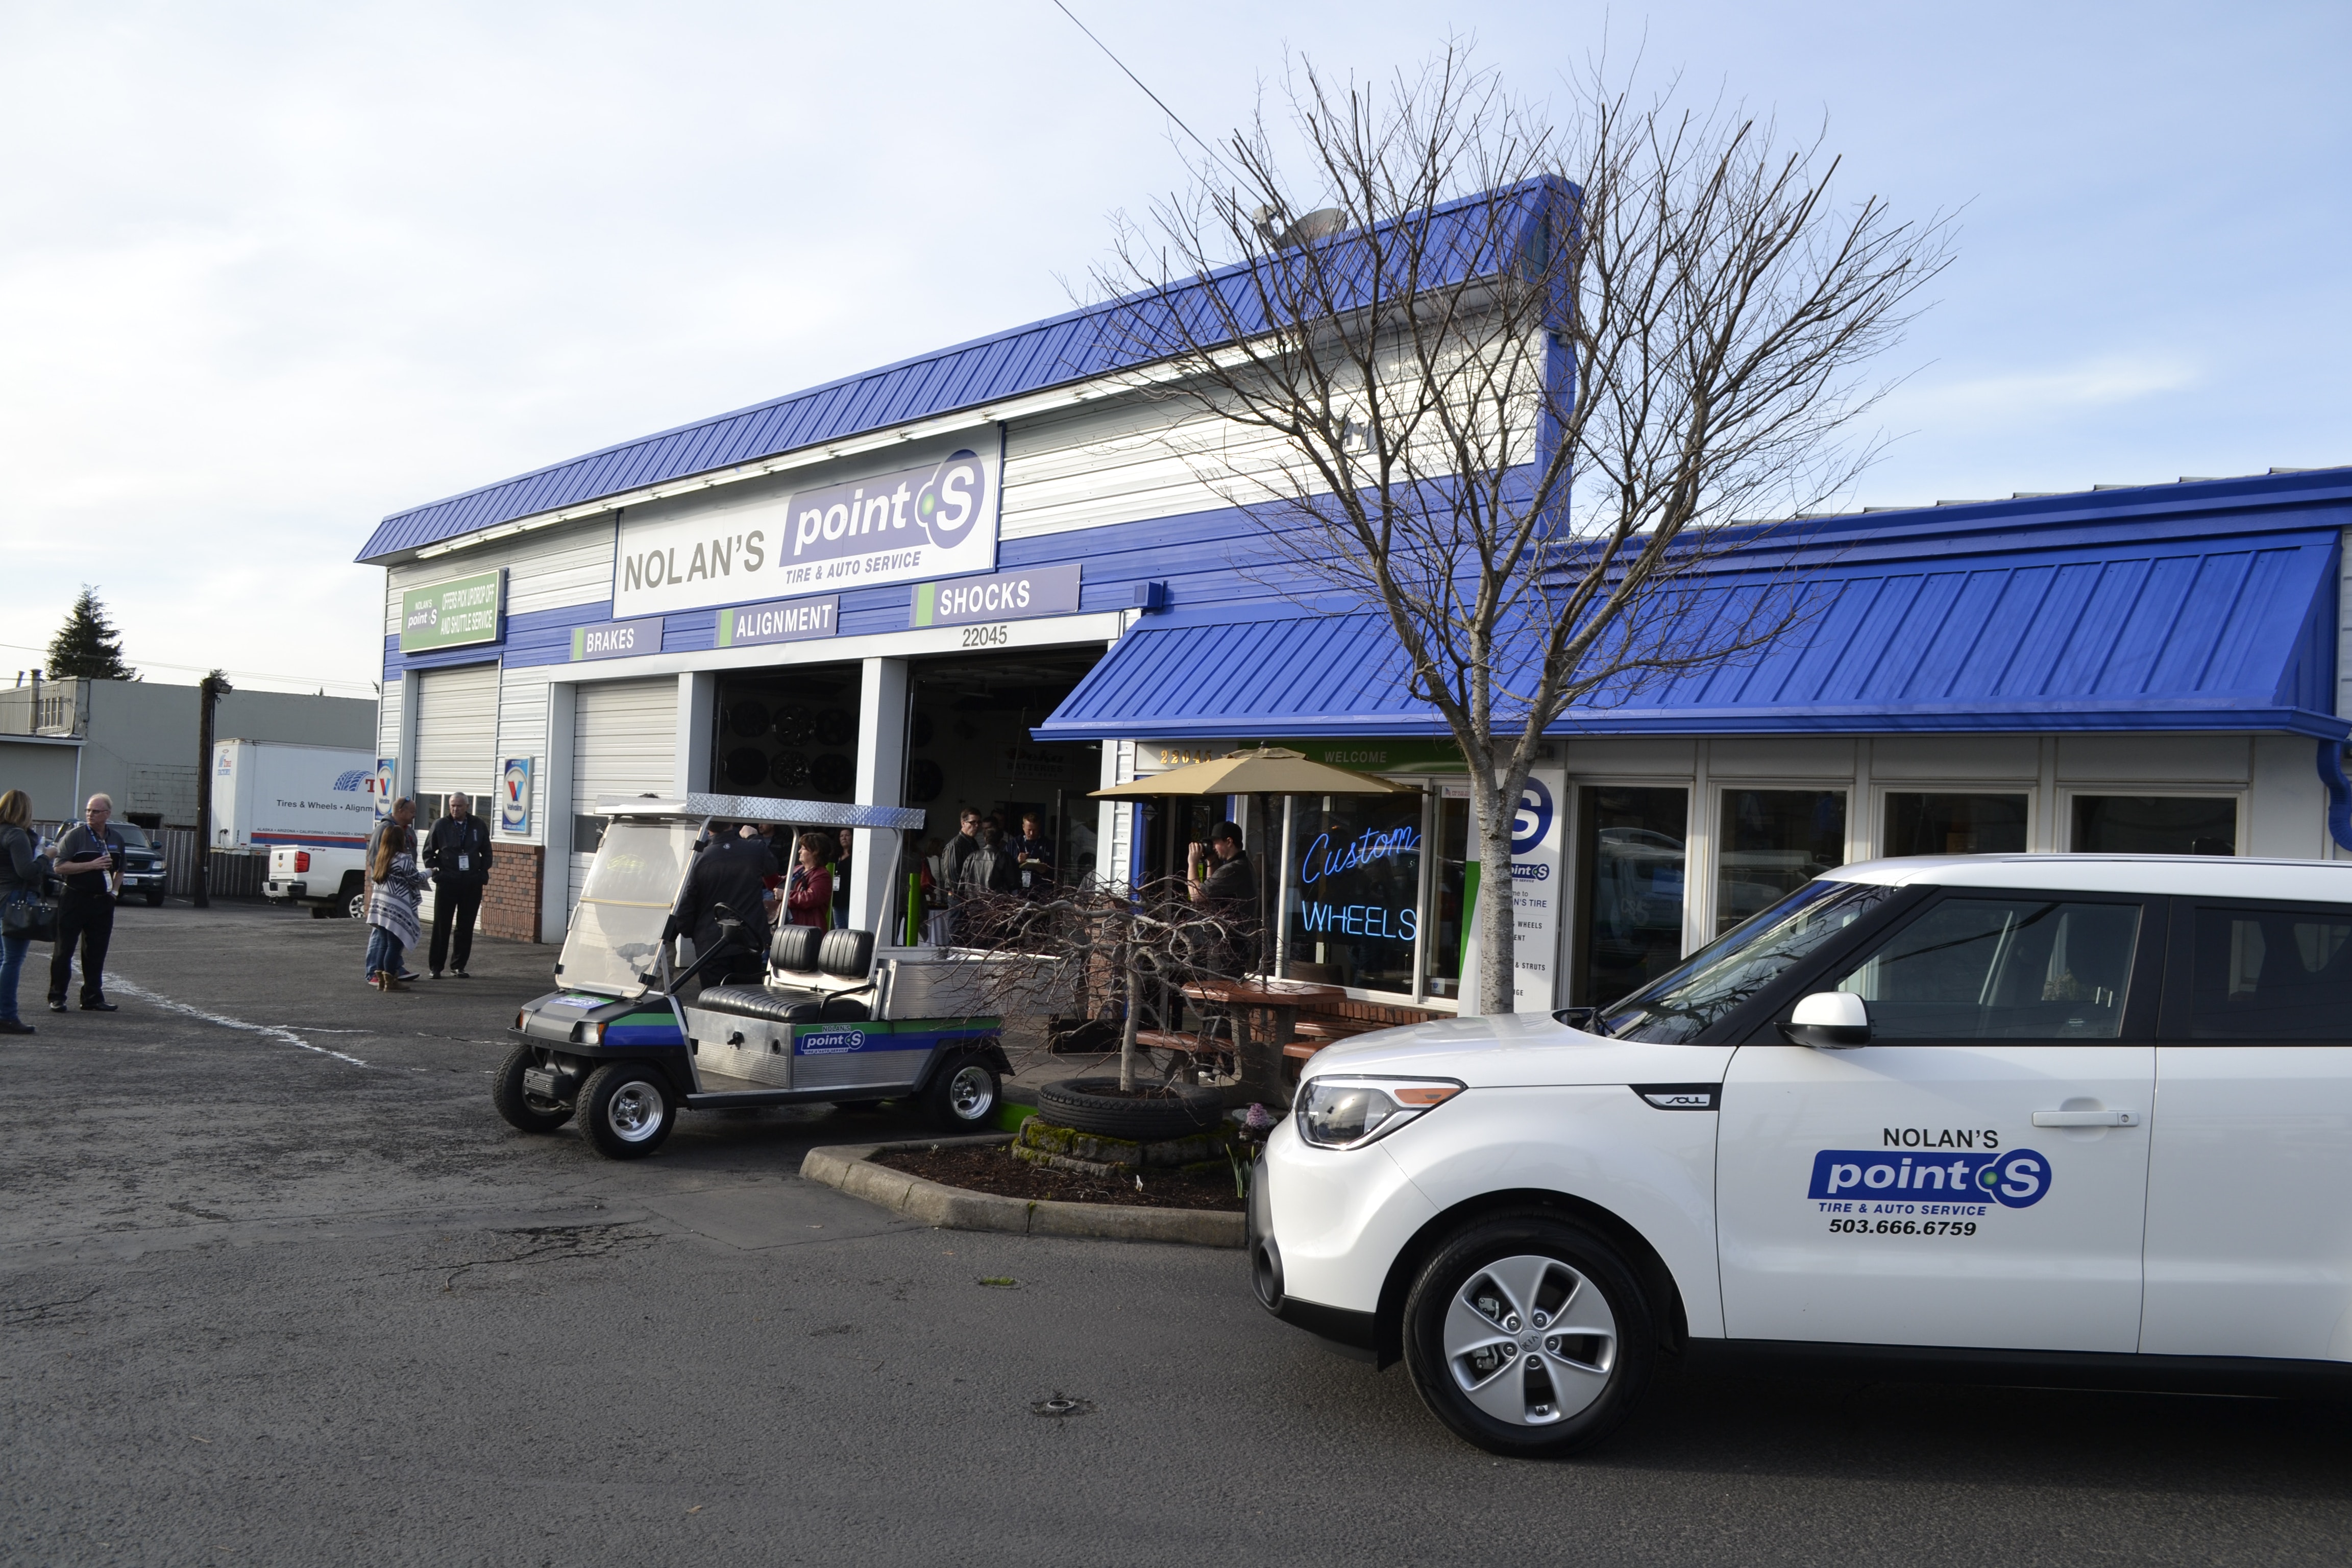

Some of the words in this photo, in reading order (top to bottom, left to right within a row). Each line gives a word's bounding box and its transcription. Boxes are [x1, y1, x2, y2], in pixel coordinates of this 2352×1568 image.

[794, 481, 911, 556] point
[937, 465, 974, 531] S
[624, 530, 764, 592] NOLAN'S
[786, 567, 812, 584] TIRE
[815, 566, 823, 580] &
[826, 560, 860, 578] AUTO
[865, 551, 921, 574] SERVICE
[415, 599, 432, 610] NOLAN'S
[442, 591, 458, 611] OFFERS
[485, 583, 495, 603] OFF
[940, 579, 1031, 616] SHOCKS
[408, 611, 427, 629] point
[430, 609, 437, 625] S
[440, 617, 451, 635] AND
[451, 612, 472, 634] SHUTTLE
[472, 609, 493, 631] SERVICE
[737, 604, 832, 638] ALIGNMENT
[586, 628, 634, 653] BRAKES
[962, 625, 1008, 647] 22045
[1160, 749, 1212, 764] 22045
[1325, 751, 1387, 764] WELCOME
[1007, 763, 1064, 772] BATTERIES
[276, 799, 297, 807] Tires
[1302, 826, 1422, 883] Custom
[1537, 866, 1547, 878] S
[1529, 899, 1547, 908] TIRE
[1302, 900, 1417, 941] WHEELS
[1518, 921, 1542, 929] WHEELS
[1522, 962, 1546, 971] STRUTS
[806, 1035, 843, 1048] point
[851, 1033, 861, 1046] S
[1883, 1128, 1998, 1148] NOLAN'S
[1827, 1157, 1970, 1194] point
[2000, 1159, 2040, 1198] S
[1818, 1202, 1852, 1213] TIRE
[1859, 1204, 1868, 1214] &
[1873, 1204, 1915, 1215] AUTO
[1920, 1205, 1987, 1216] SERVICE
[1828, 1218, 1977, 1236] 503.666.6759
[1522, 1335, 1538, 1349] KIA
